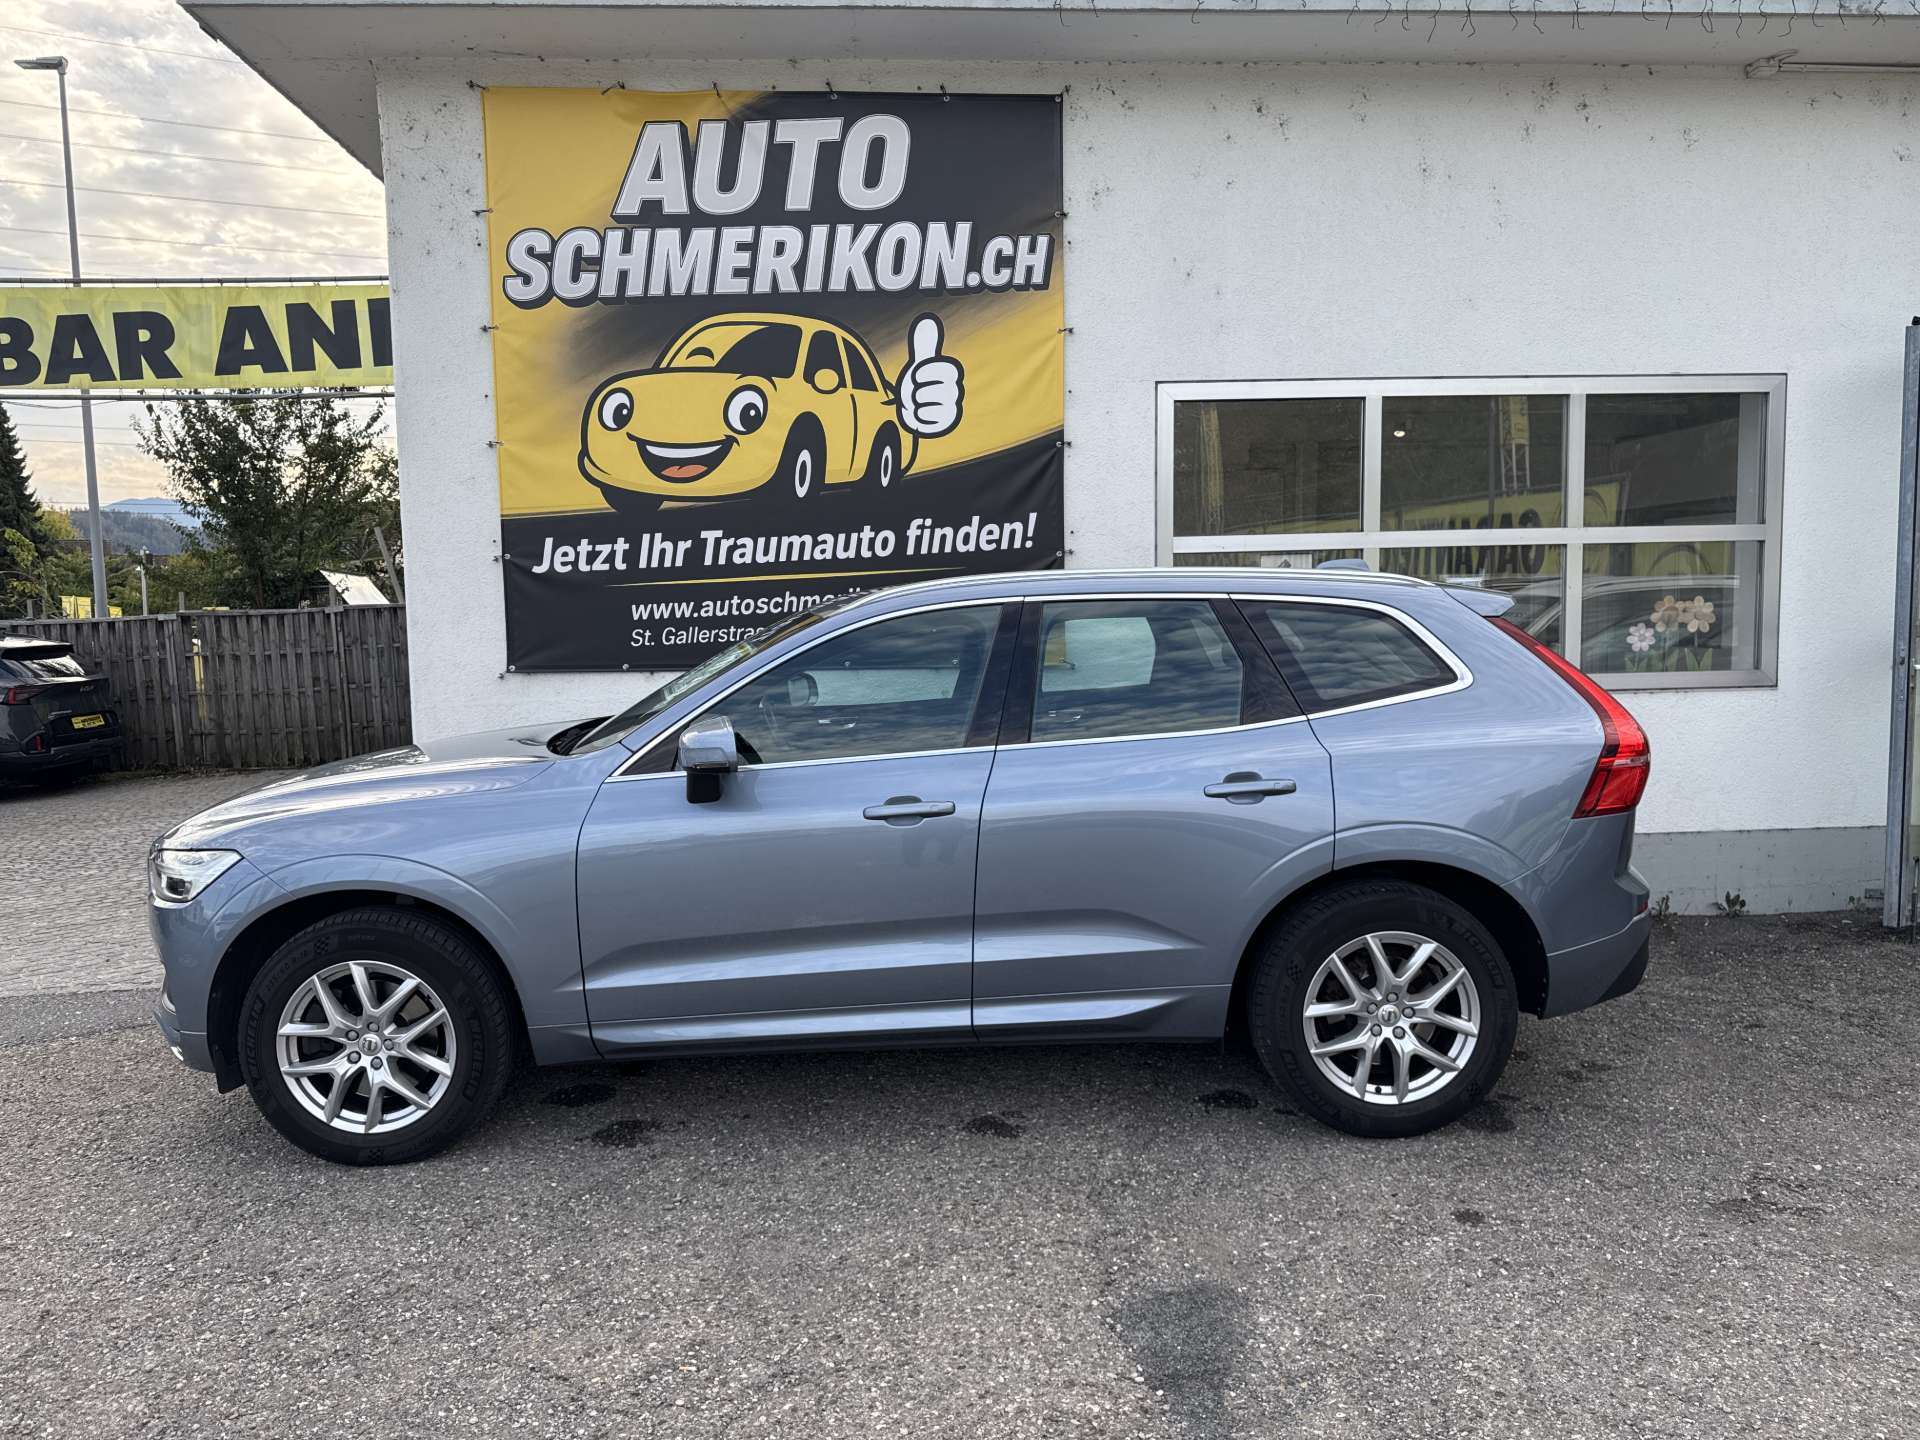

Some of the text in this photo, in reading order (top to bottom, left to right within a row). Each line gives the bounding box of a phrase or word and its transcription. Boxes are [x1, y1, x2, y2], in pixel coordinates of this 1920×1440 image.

[612, 113, 911, 218] AUTO
[503, 221, 1052, 302] SCHMERIKON.CH
[0, 311, 183, 387] BAR
[531, 512, 1039, 575] Jetzt Ihr Traumauto finden!
[630, 586, 861, 621] www.autoschm
[630, 628, 655, 647] St.
